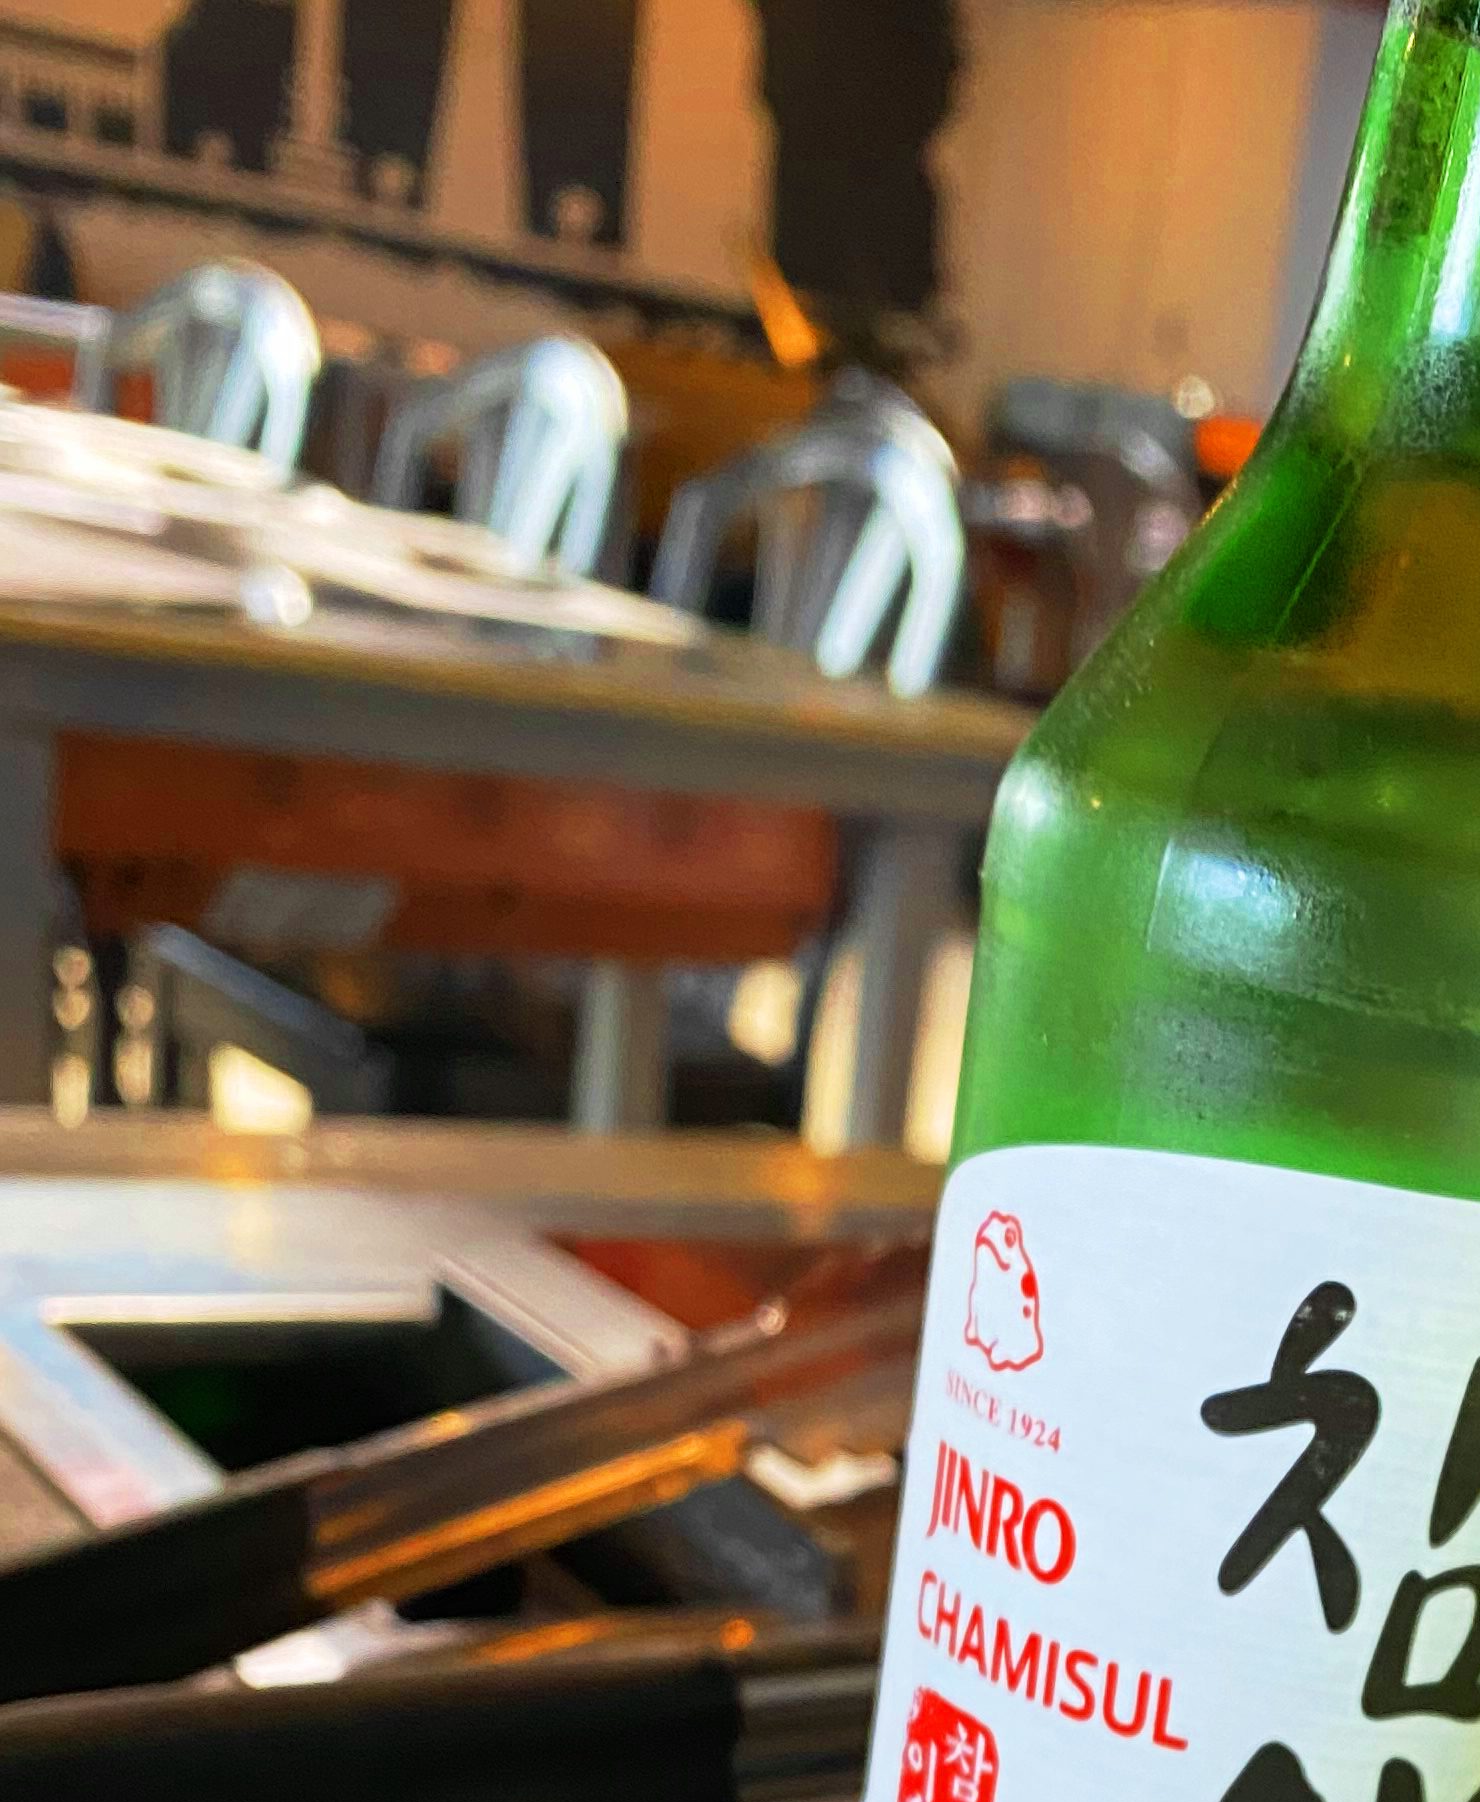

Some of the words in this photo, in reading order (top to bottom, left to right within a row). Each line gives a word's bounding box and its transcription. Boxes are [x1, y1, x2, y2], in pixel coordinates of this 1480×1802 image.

[945, 1369, 1001, 1426] SINCE
[1008, 1407, 1062, 1453] 1924
[926, 1439, 1077, 1585] JINRO
[917, 1569, 1189, 1752] CHAMISUL
